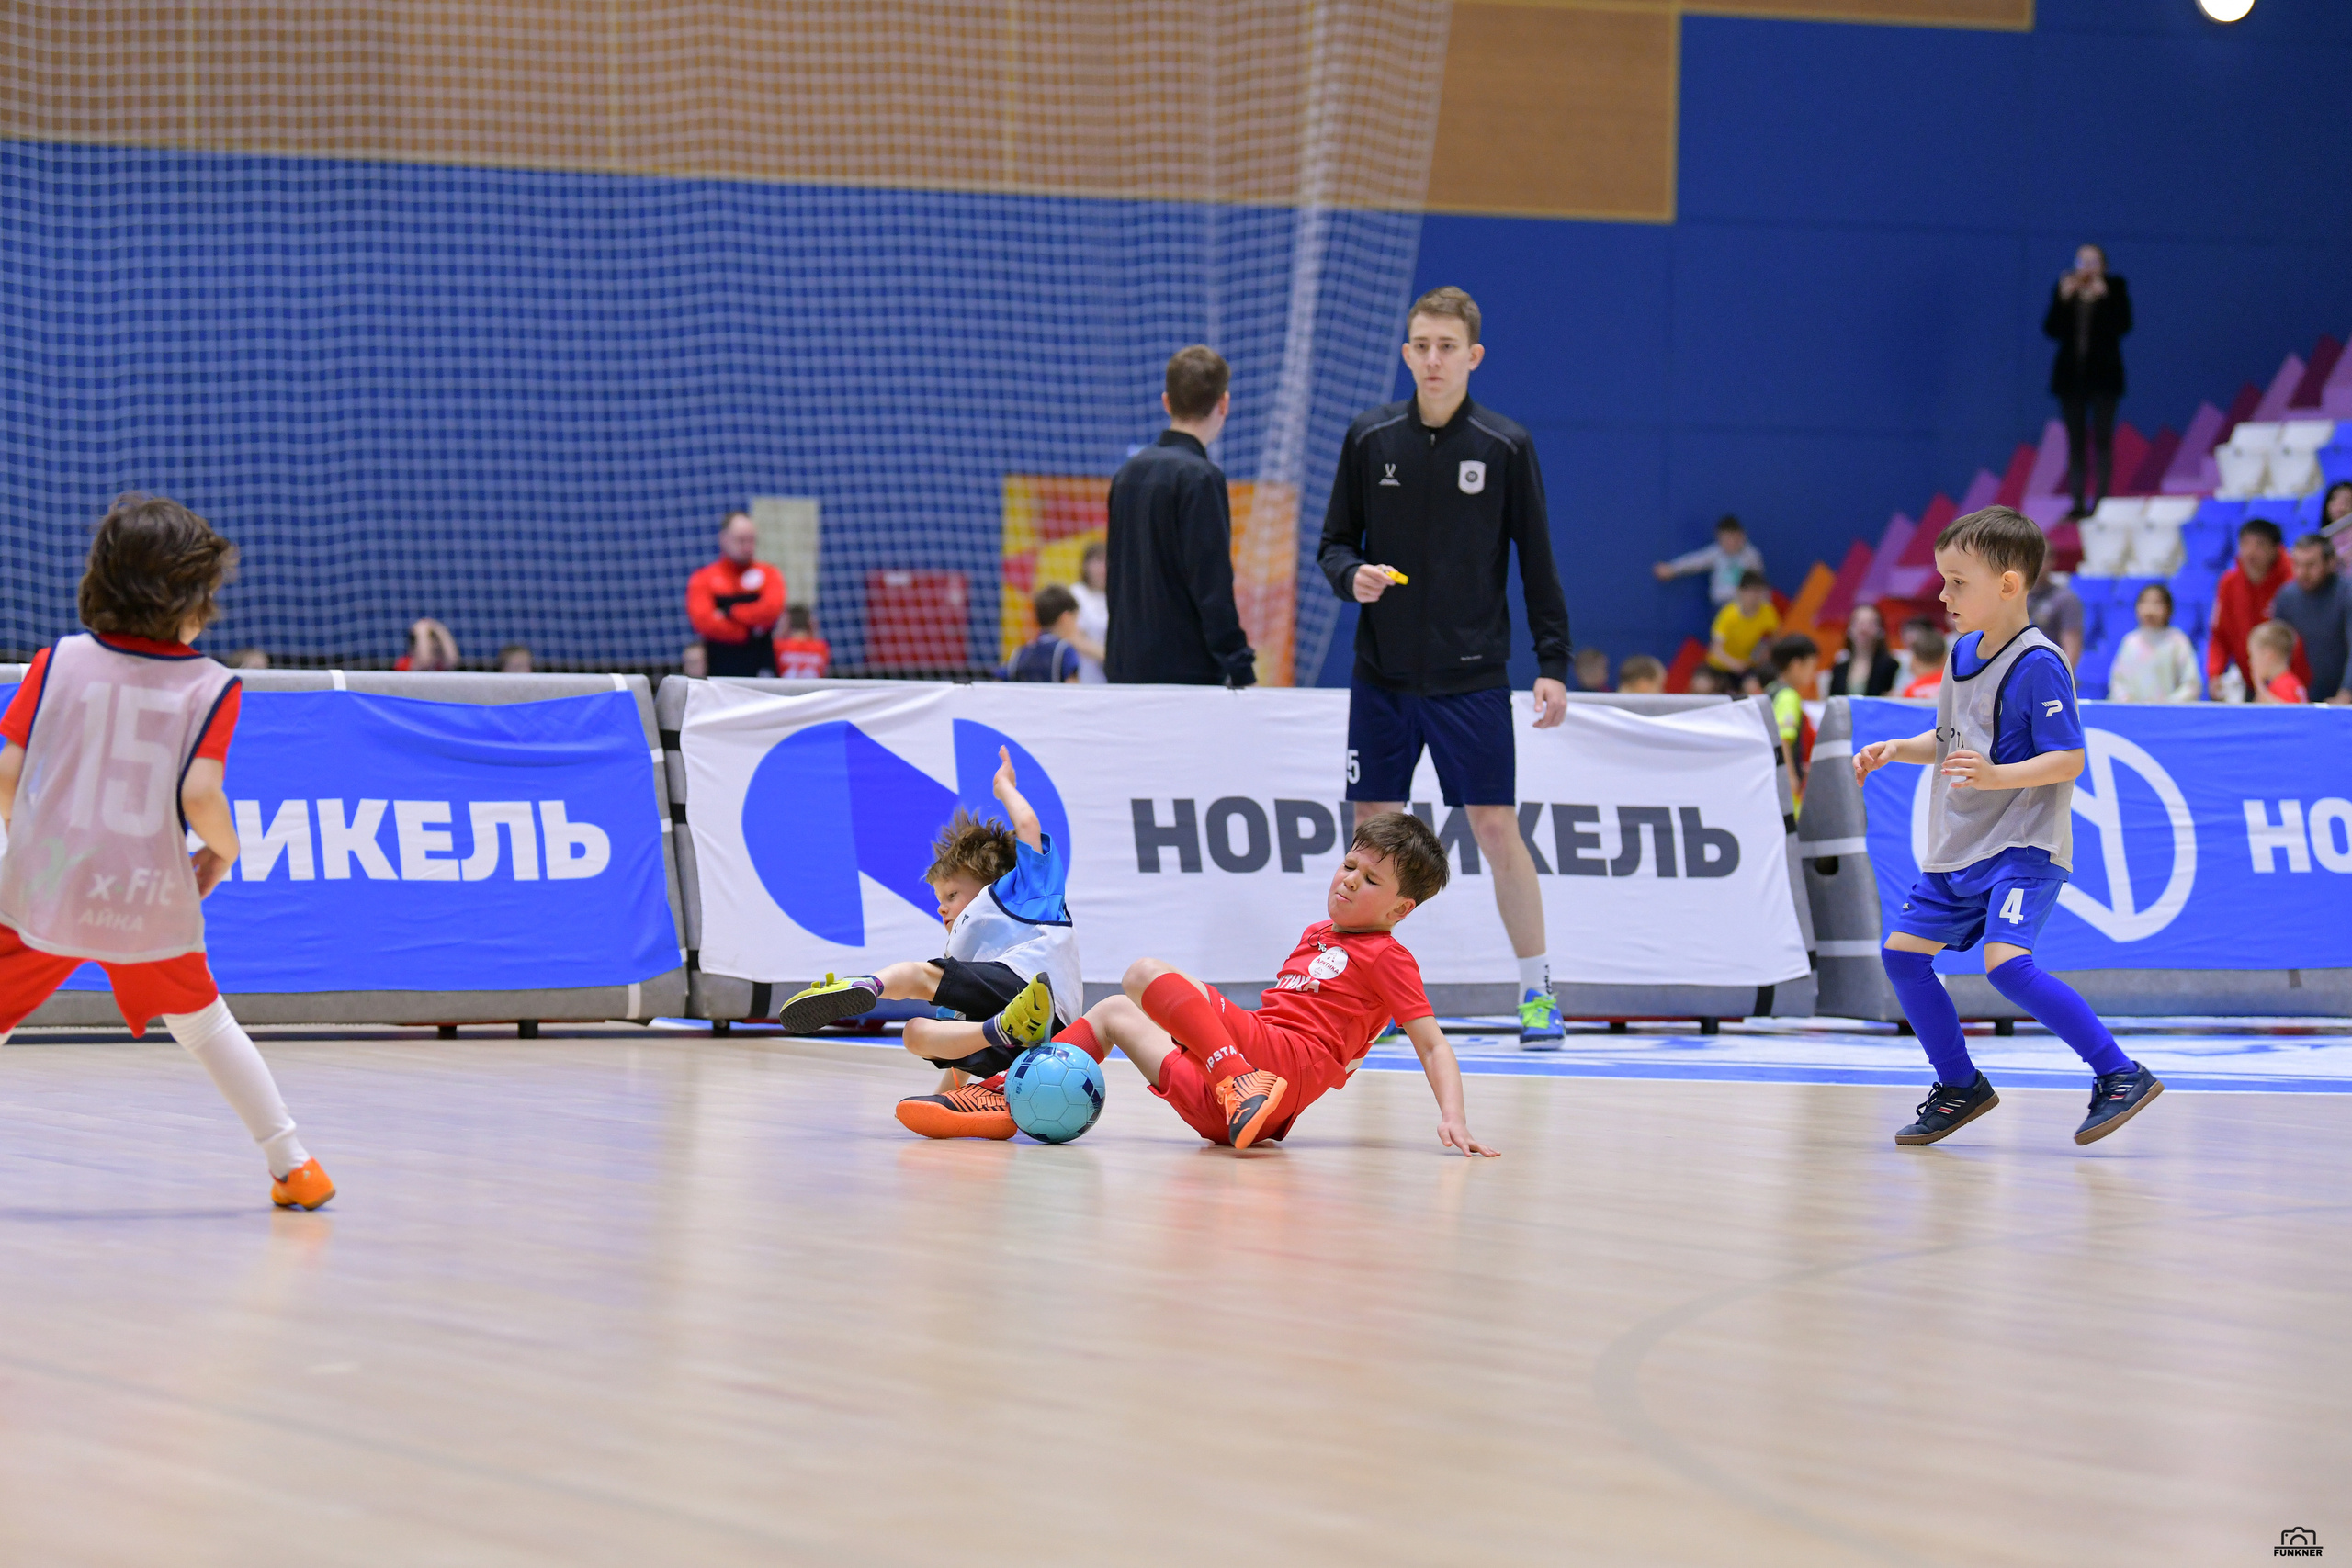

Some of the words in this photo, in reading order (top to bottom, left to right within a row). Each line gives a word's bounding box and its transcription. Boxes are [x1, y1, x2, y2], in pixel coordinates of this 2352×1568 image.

[69, 682, 184, 838] 15
[187, 797, 611, 882] ИКЕЛЬ
[1998, 887, 2024, 925] 4
